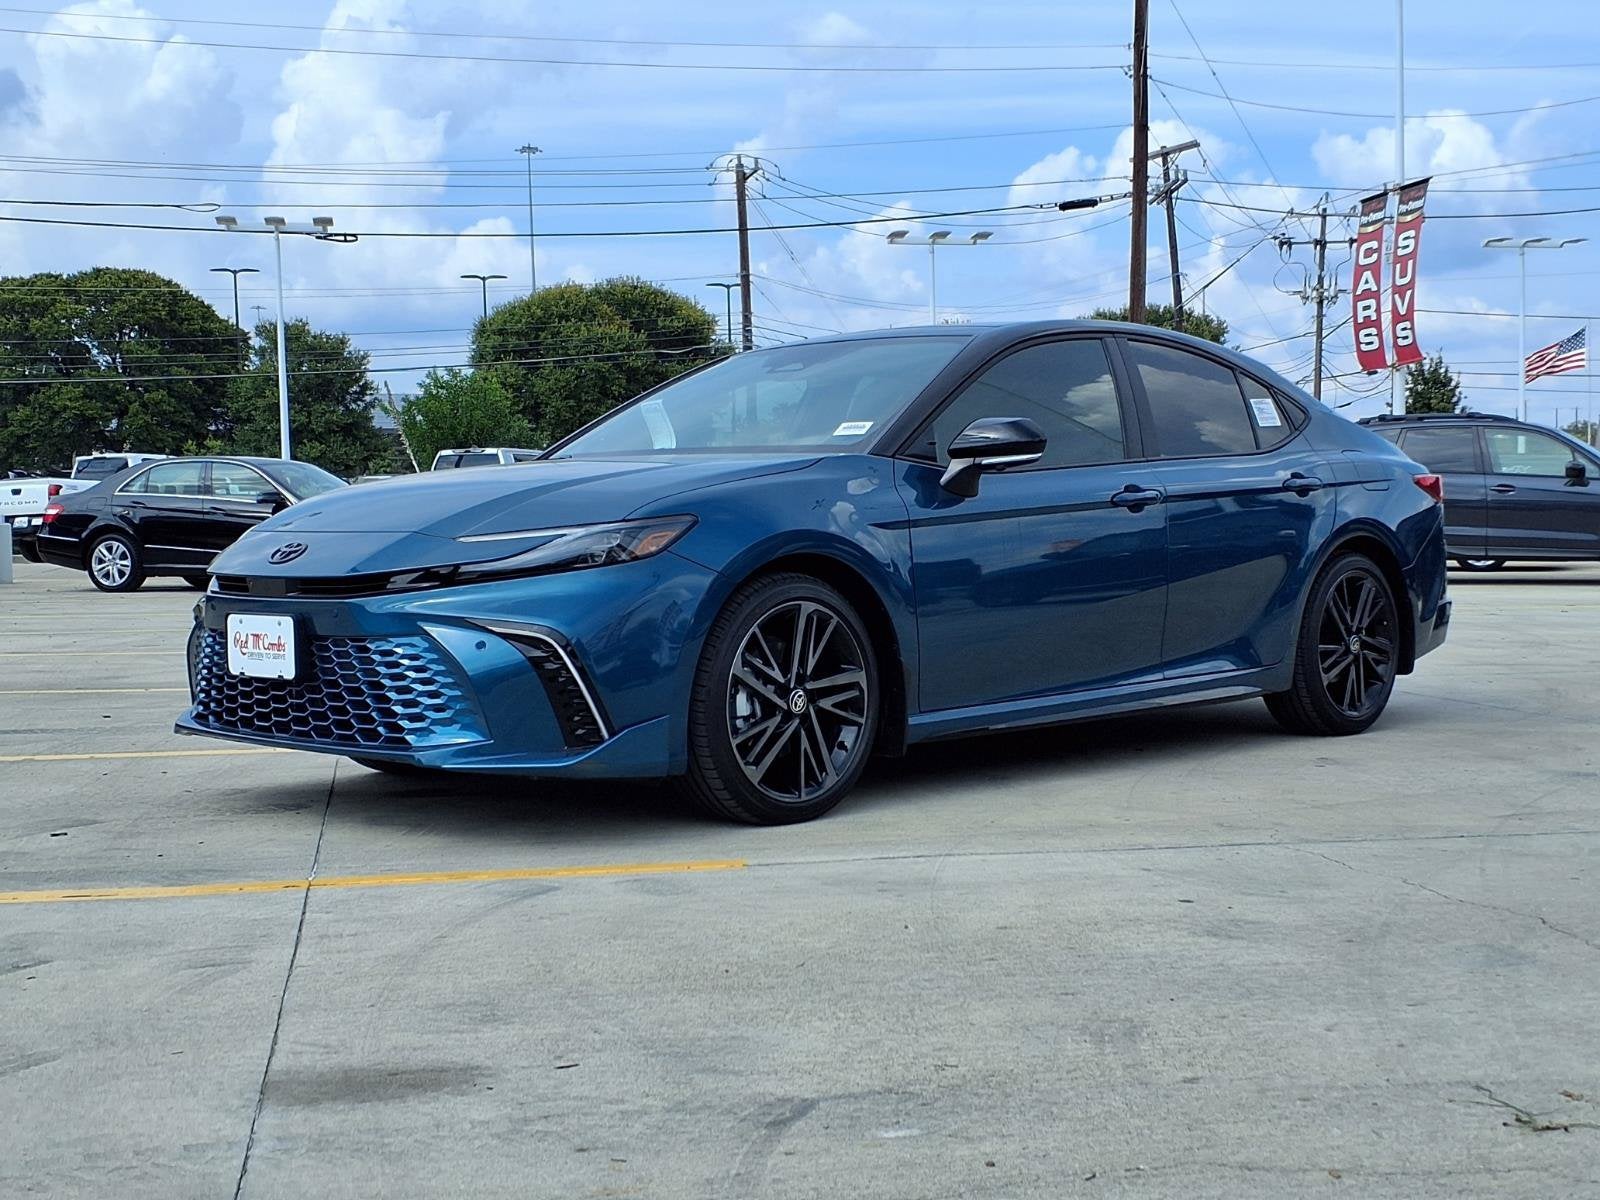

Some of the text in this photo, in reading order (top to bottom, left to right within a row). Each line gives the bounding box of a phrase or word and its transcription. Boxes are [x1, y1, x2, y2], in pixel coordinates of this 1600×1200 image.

[1356, 241, 1379, 351] CARS
[1394, 230, 1415, 346] SUVS
[234, 631, 286, 655] Red McCombs
